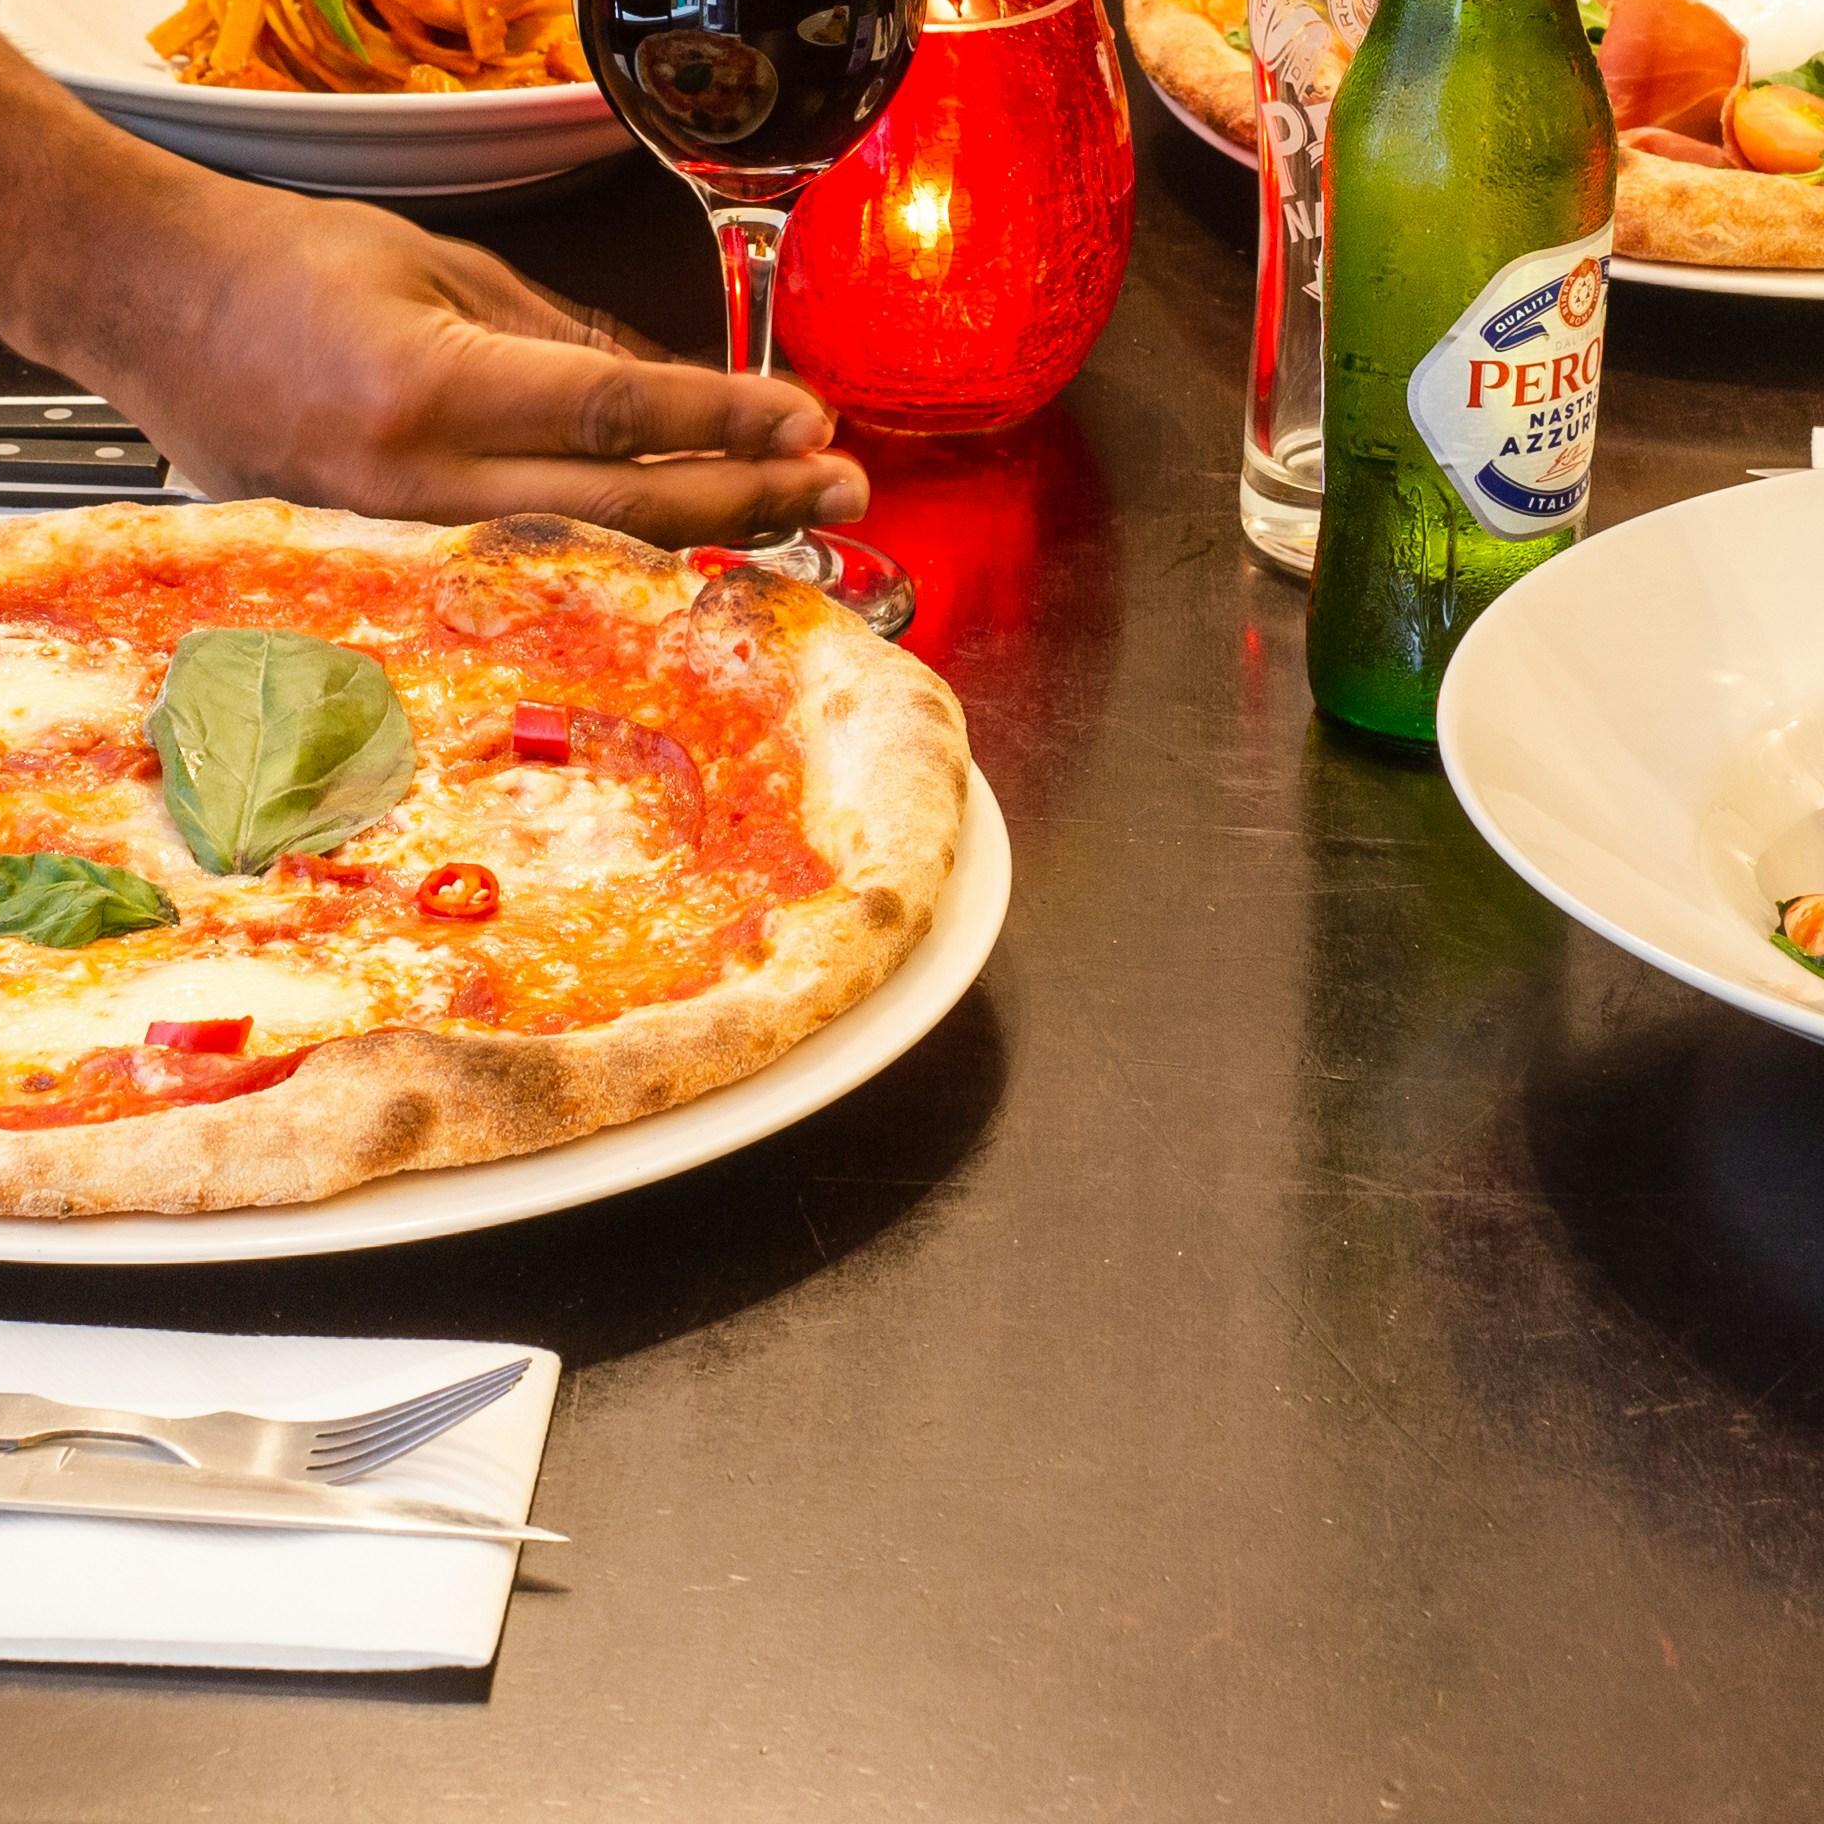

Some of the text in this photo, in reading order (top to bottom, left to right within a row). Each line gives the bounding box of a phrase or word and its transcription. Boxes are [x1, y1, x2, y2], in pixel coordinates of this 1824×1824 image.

[1494, 290, 1554, 333] QUALITÀ
[1466, 337, 1600, 409] PERO
[1499, 404, 1596, 456] AZZUR
